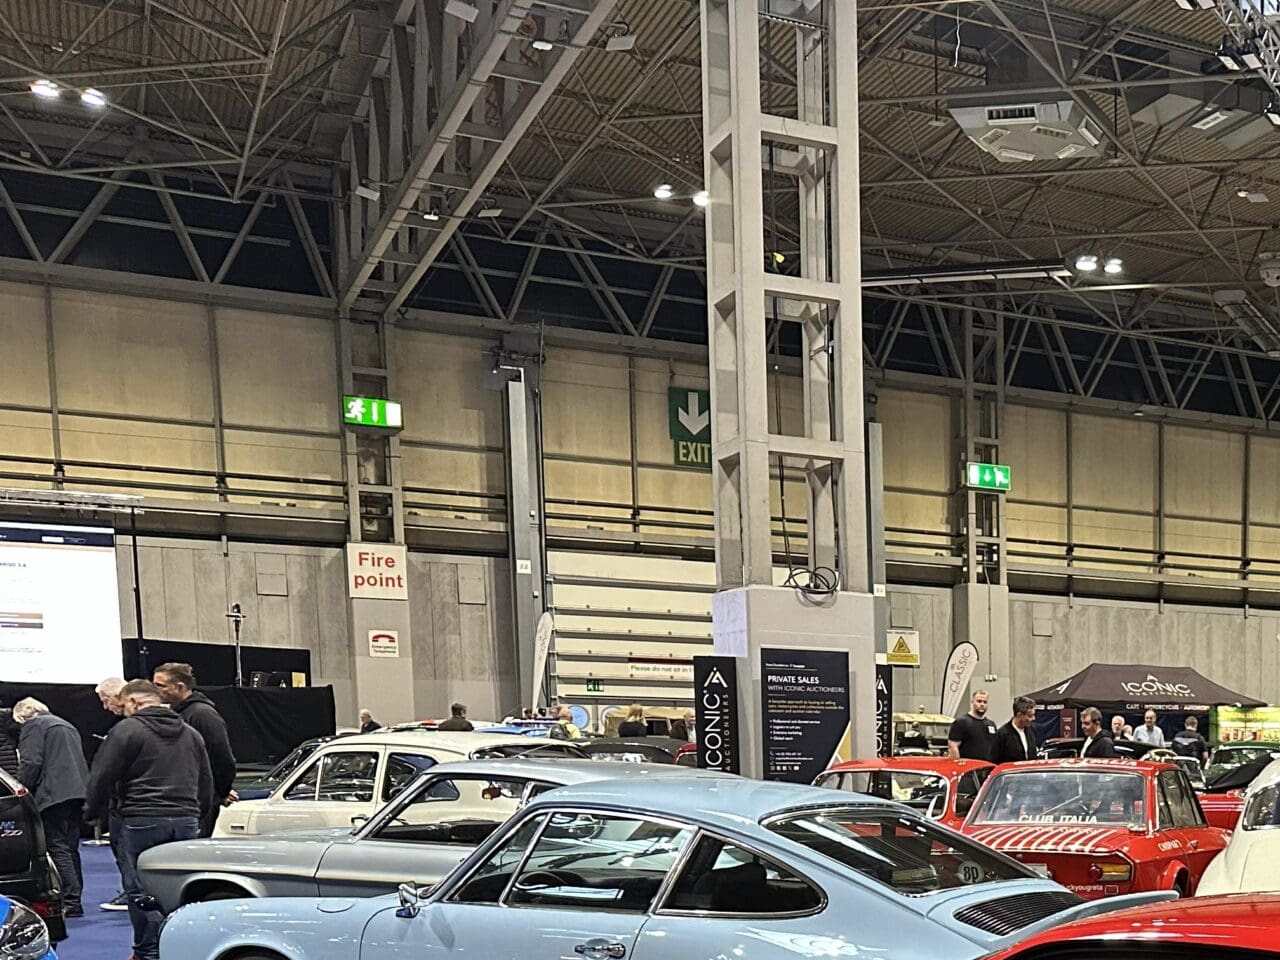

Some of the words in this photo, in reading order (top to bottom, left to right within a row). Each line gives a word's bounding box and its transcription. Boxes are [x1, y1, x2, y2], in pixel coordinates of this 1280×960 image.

[679, 441, 710, 463] EXIT
[358, 552, 395, 568] Fire
[354, 573, 403, 589] point
[949, 648, 972, 693] CLASSIC
[768, 675, 796, 684] PRIVATE
[797, 676, 820, 684] SALES
[1121, 681, 1191, 693] ICONIC
[703, 693, 723, 770] ICONIC
[722, 694, 731, 771] AUCTIONEERS
[1018, 814, 1054, 825] CLUB
[1059, 814, 1098, 825] ITALIA
